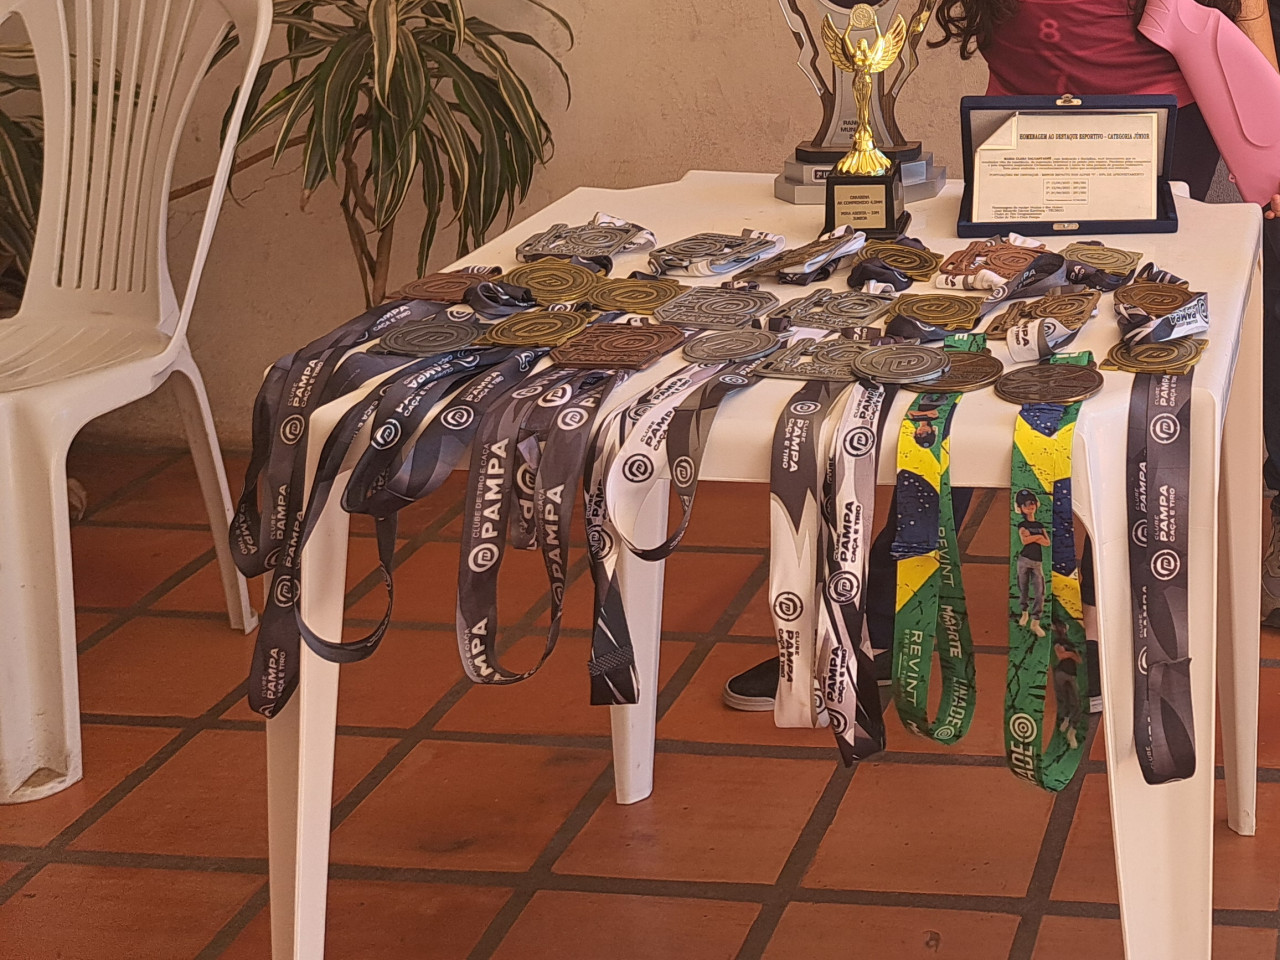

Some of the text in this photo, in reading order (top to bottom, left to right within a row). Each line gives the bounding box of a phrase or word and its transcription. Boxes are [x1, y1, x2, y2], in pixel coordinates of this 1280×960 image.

[1039, 19, 1061, 42] 8
[292, 359, 318, 408] PAMPA
[301, 385, 312, 408] CAÇA
[313, 361, 324, 379] TIRO
[466, 371, 501, 401] PAMPA
[653, 378, 687, 401] PAMPA
[404, 396, 421, 416] CAÇA
[854, 399, 863, 418] CLUBE
[641, 421, 655, 441] CLUBE
[645, 406, 679, 447] PAMPA
[785, 418, 795, 440] CAÇA
[481, 443, 490, 466] CAÇA
[782, 448, 791, 469] TIRO
[789, 419, 804, 472] PAMPA
[476, 476, 484, 498] TIRO
[481, 438, 509, 539] PAMPA
[475, 498, 482, 509] DE
[586, 493, 595, 518] CLUBE
[854, 505, 862, 526] TIRO
[1160, 485, 1169, 542] PAMPA
[473, 511, 481, 538] CLUBE
[546, 484, 564, 581] PAMPA
[840, 501, 855, 563] PAMPA
[285, 511, 304, 567] PAMPA
[850, 537, 859, 563] CAÇA
[778, 628, 786, 649] CAÇA
[785, 630, 795, 683] PAMPA
[906, 630, 923, 706] REVINT
[267, 648, 279, 699] PAMPA
[827, 645, 841, 702] PAMPA
